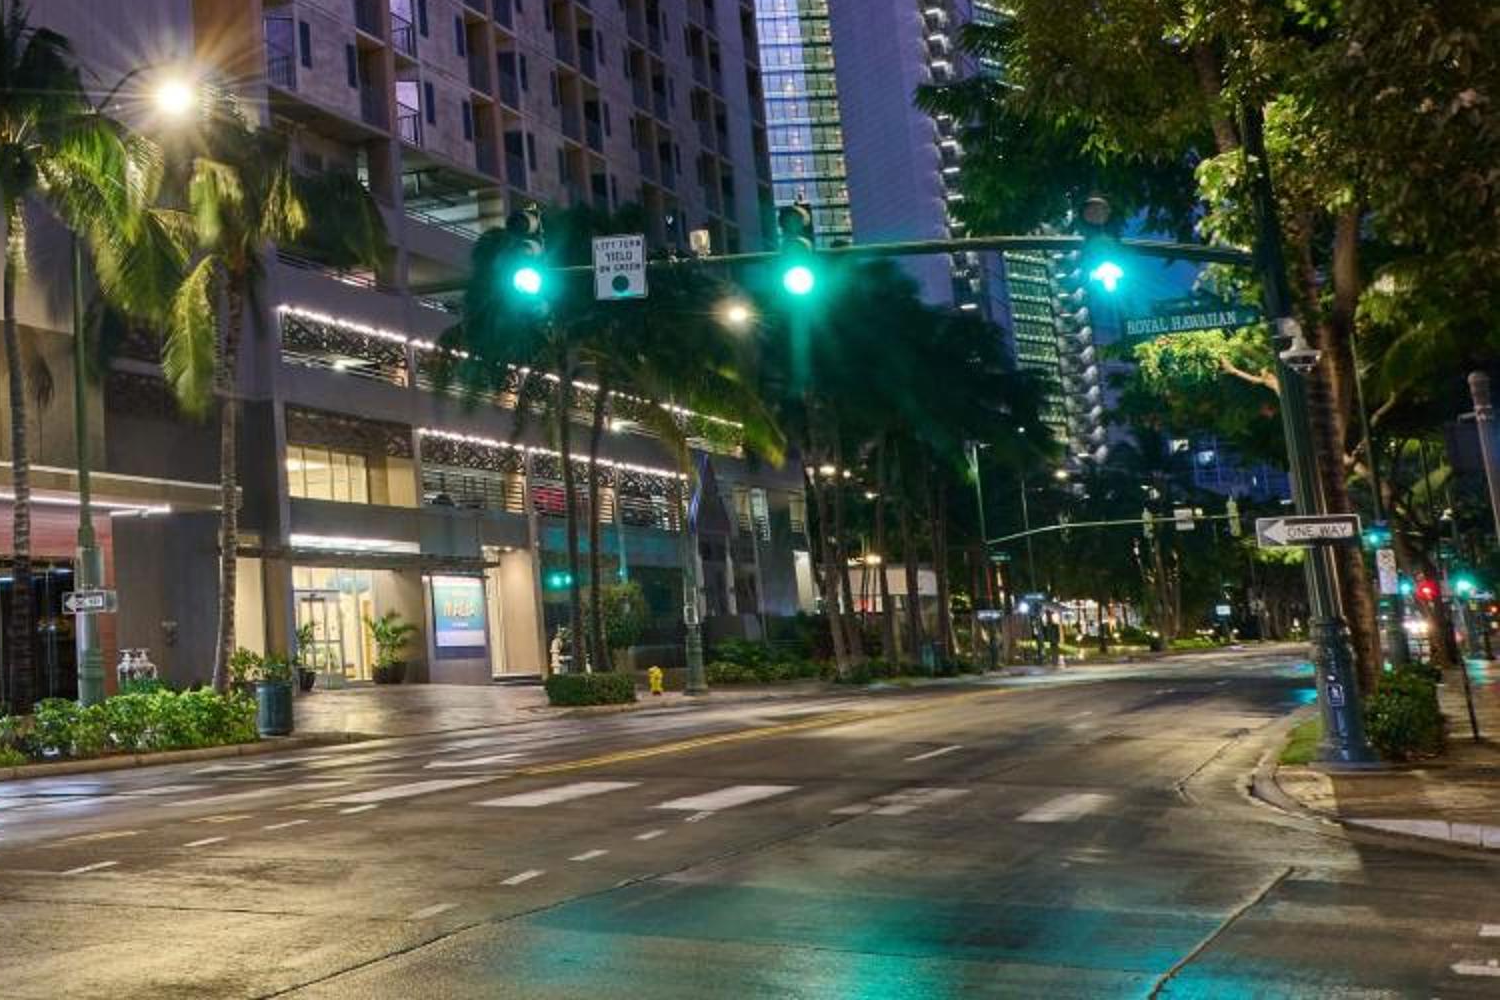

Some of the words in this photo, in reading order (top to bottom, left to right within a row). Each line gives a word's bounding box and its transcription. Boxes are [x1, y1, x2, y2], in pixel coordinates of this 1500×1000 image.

[1127, 318, 1169, 335] ROYAL
[1171, 311, 1237, 331] HAWAIIAN
[1287, 525, 1314, 538] ONE
[1320, 523, 1347, 536] WAY
